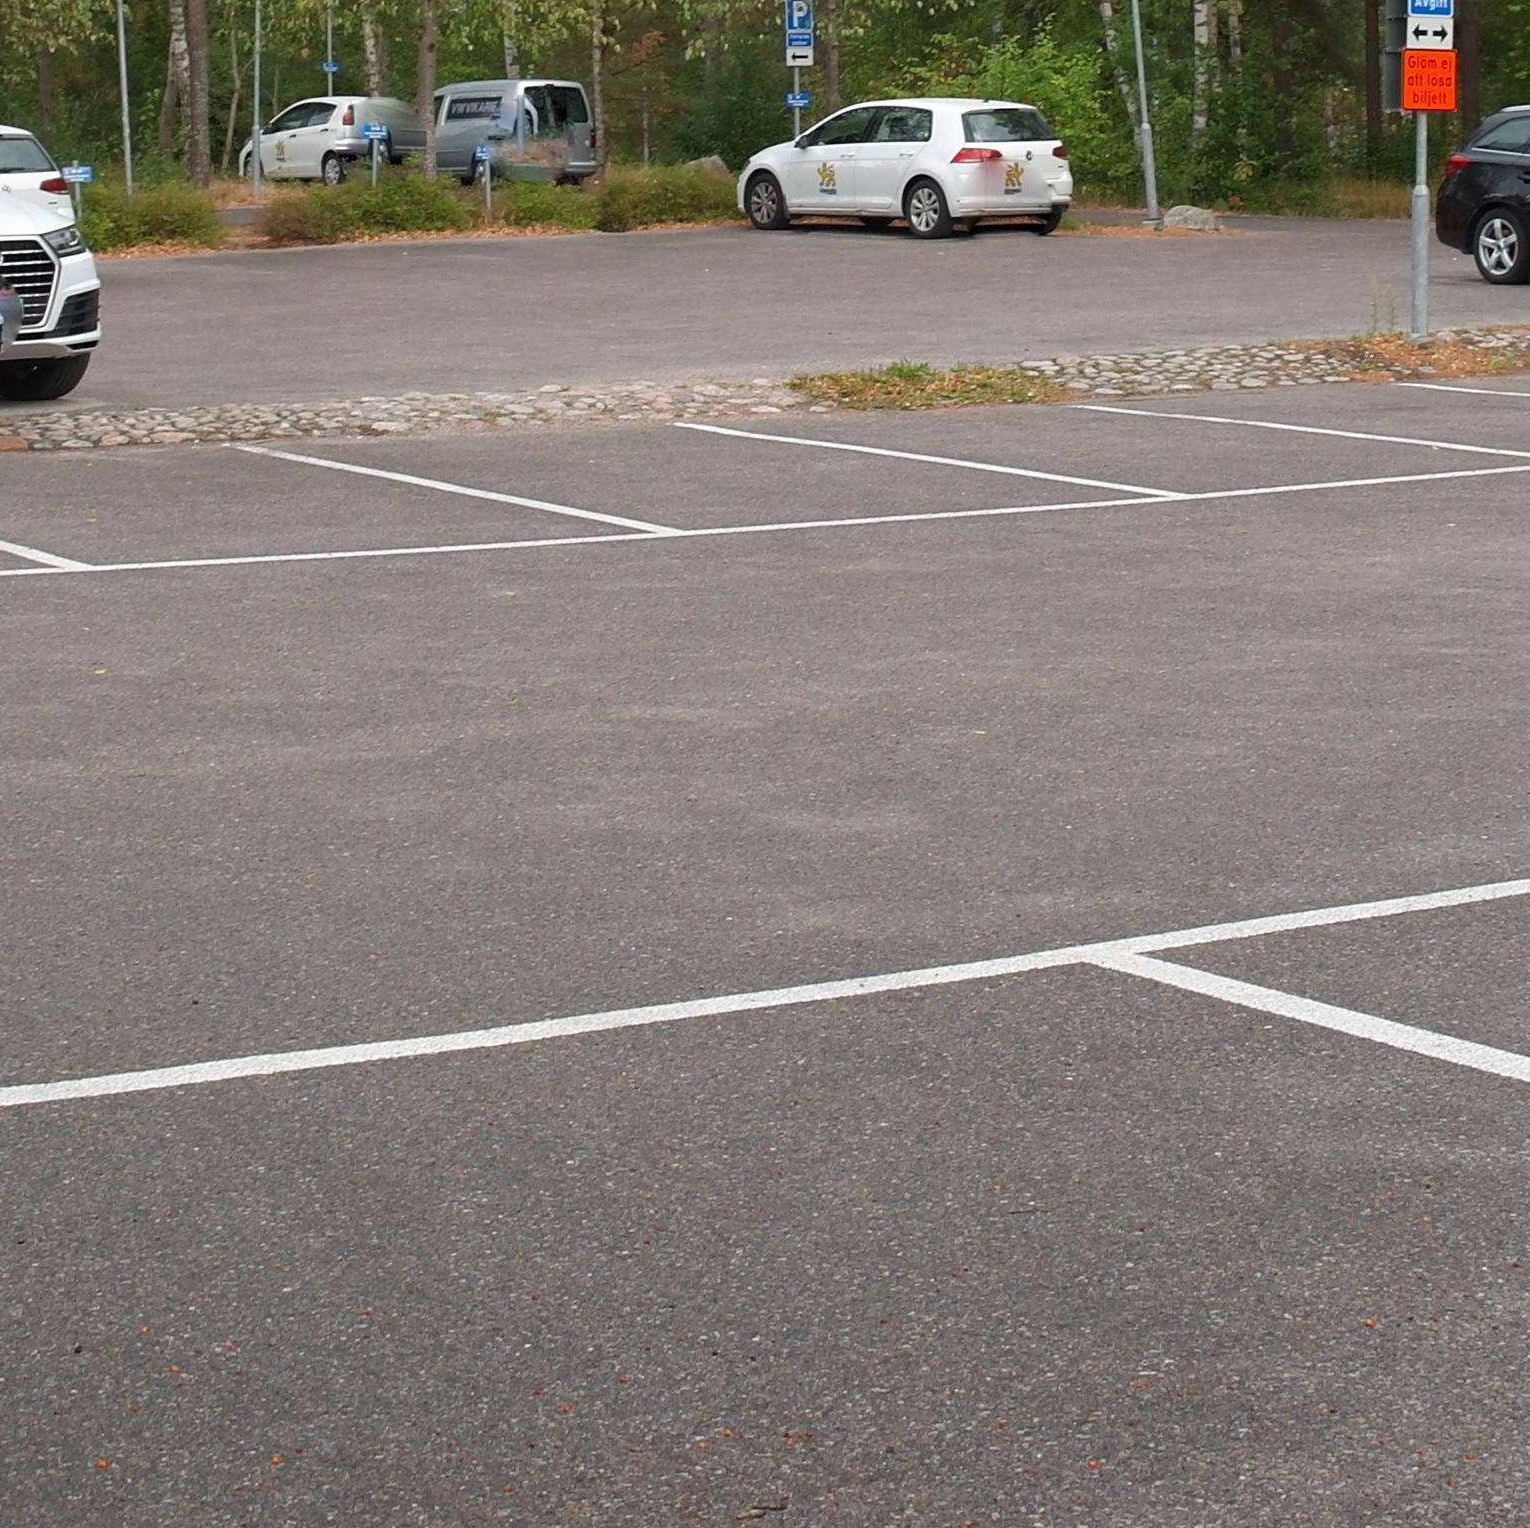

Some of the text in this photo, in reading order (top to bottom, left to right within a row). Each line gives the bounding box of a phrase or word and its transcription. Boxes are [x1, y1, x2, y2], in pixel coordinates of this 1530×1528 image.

[792, 0, 808, 28] P
[1408, 55, 1452, 72] Glöm ej
[1407, 74, 1423, 86] att
[1413, 90, 1446, 106] biljett
